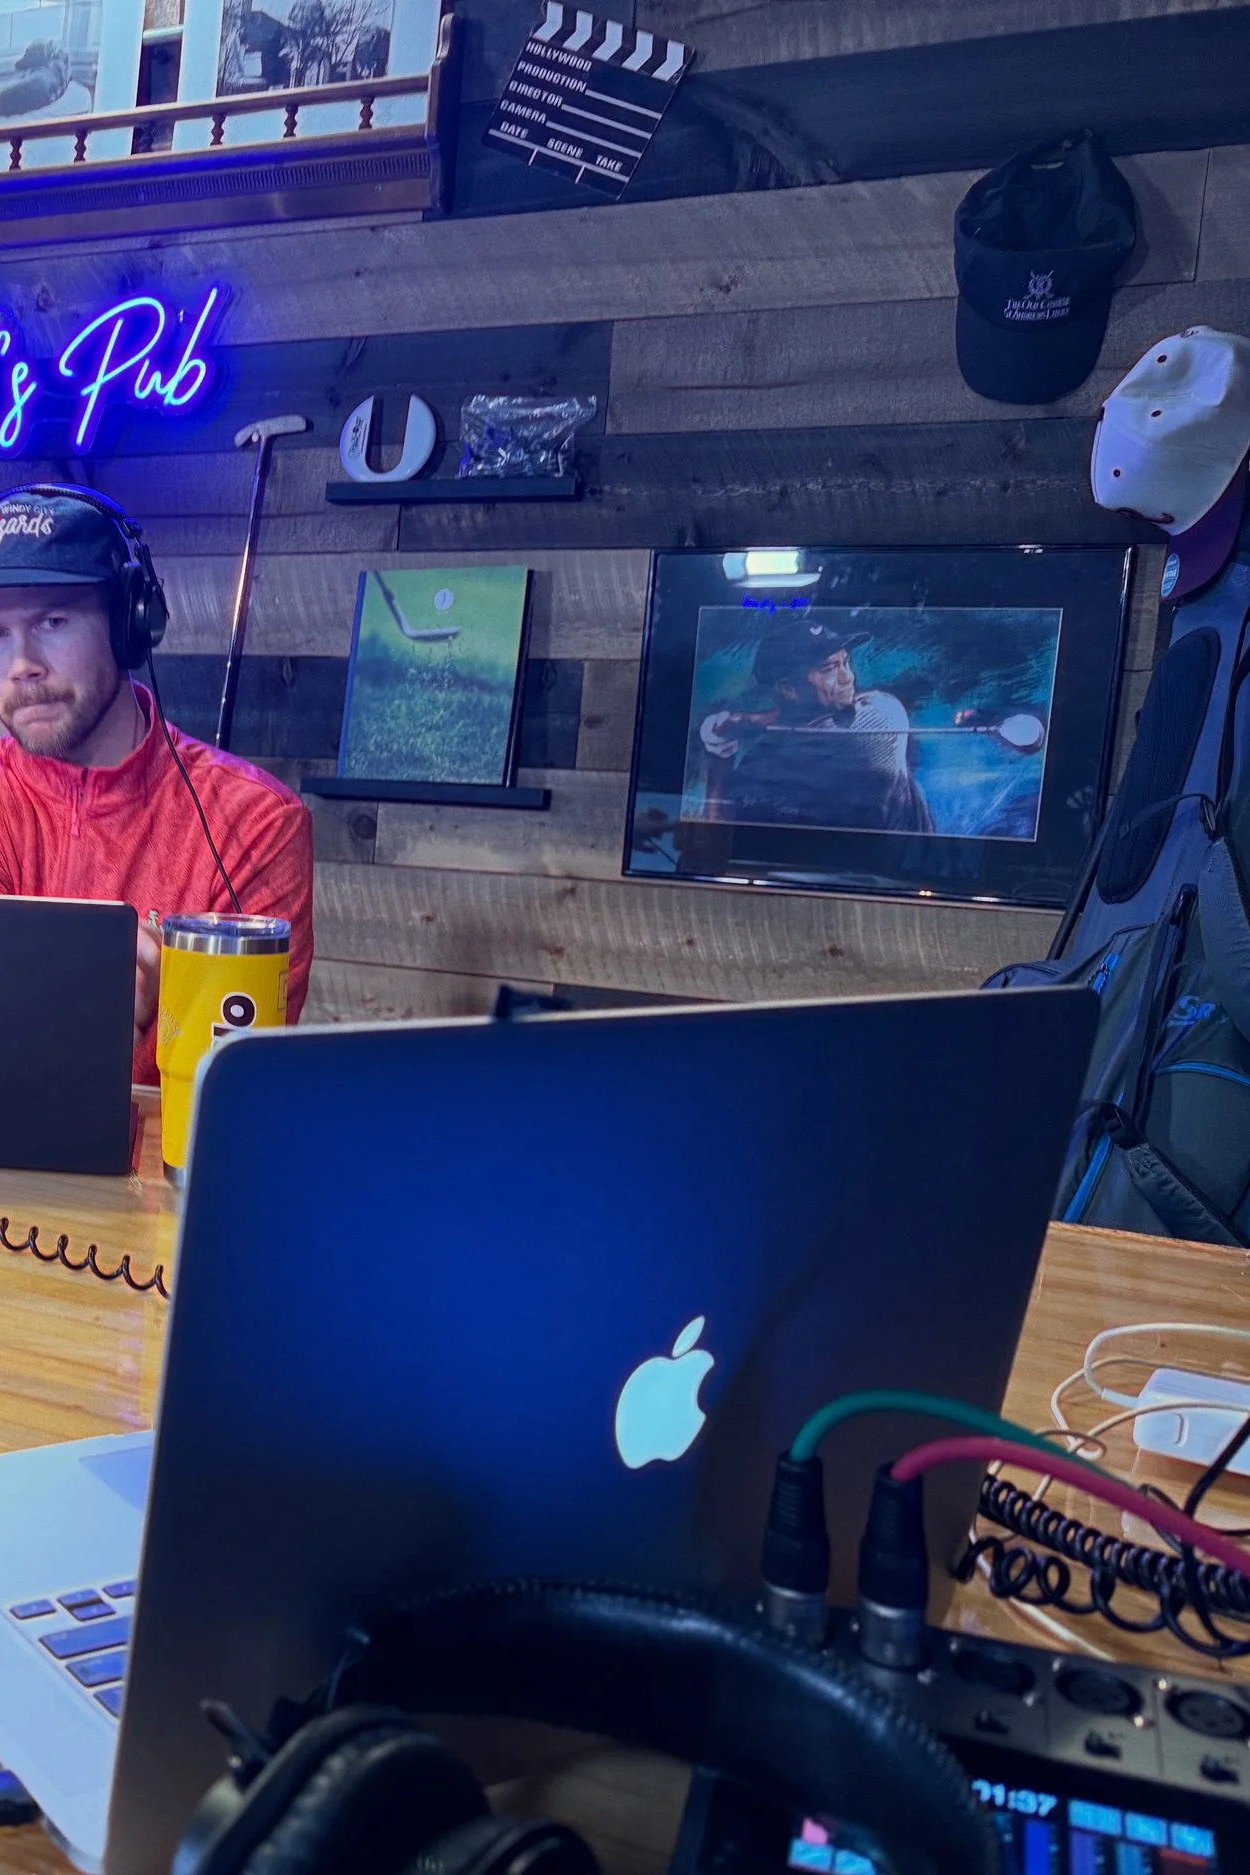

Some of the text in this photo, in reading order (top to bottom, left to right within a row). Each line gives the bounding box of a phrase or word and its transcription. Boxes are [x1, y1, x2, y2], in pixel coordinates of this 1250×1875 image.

[526, 41, 593, 72] HOLLYWOOD
[517, 60, 587, 93] PRODUCTION
[508, 80, 563, 107] DIRECTOR
[500, 100, 547, 123] CAMERA
[500, 121, 623, 173] DATE SCENE TAKE
[59, 286, 218, 446] Pub
